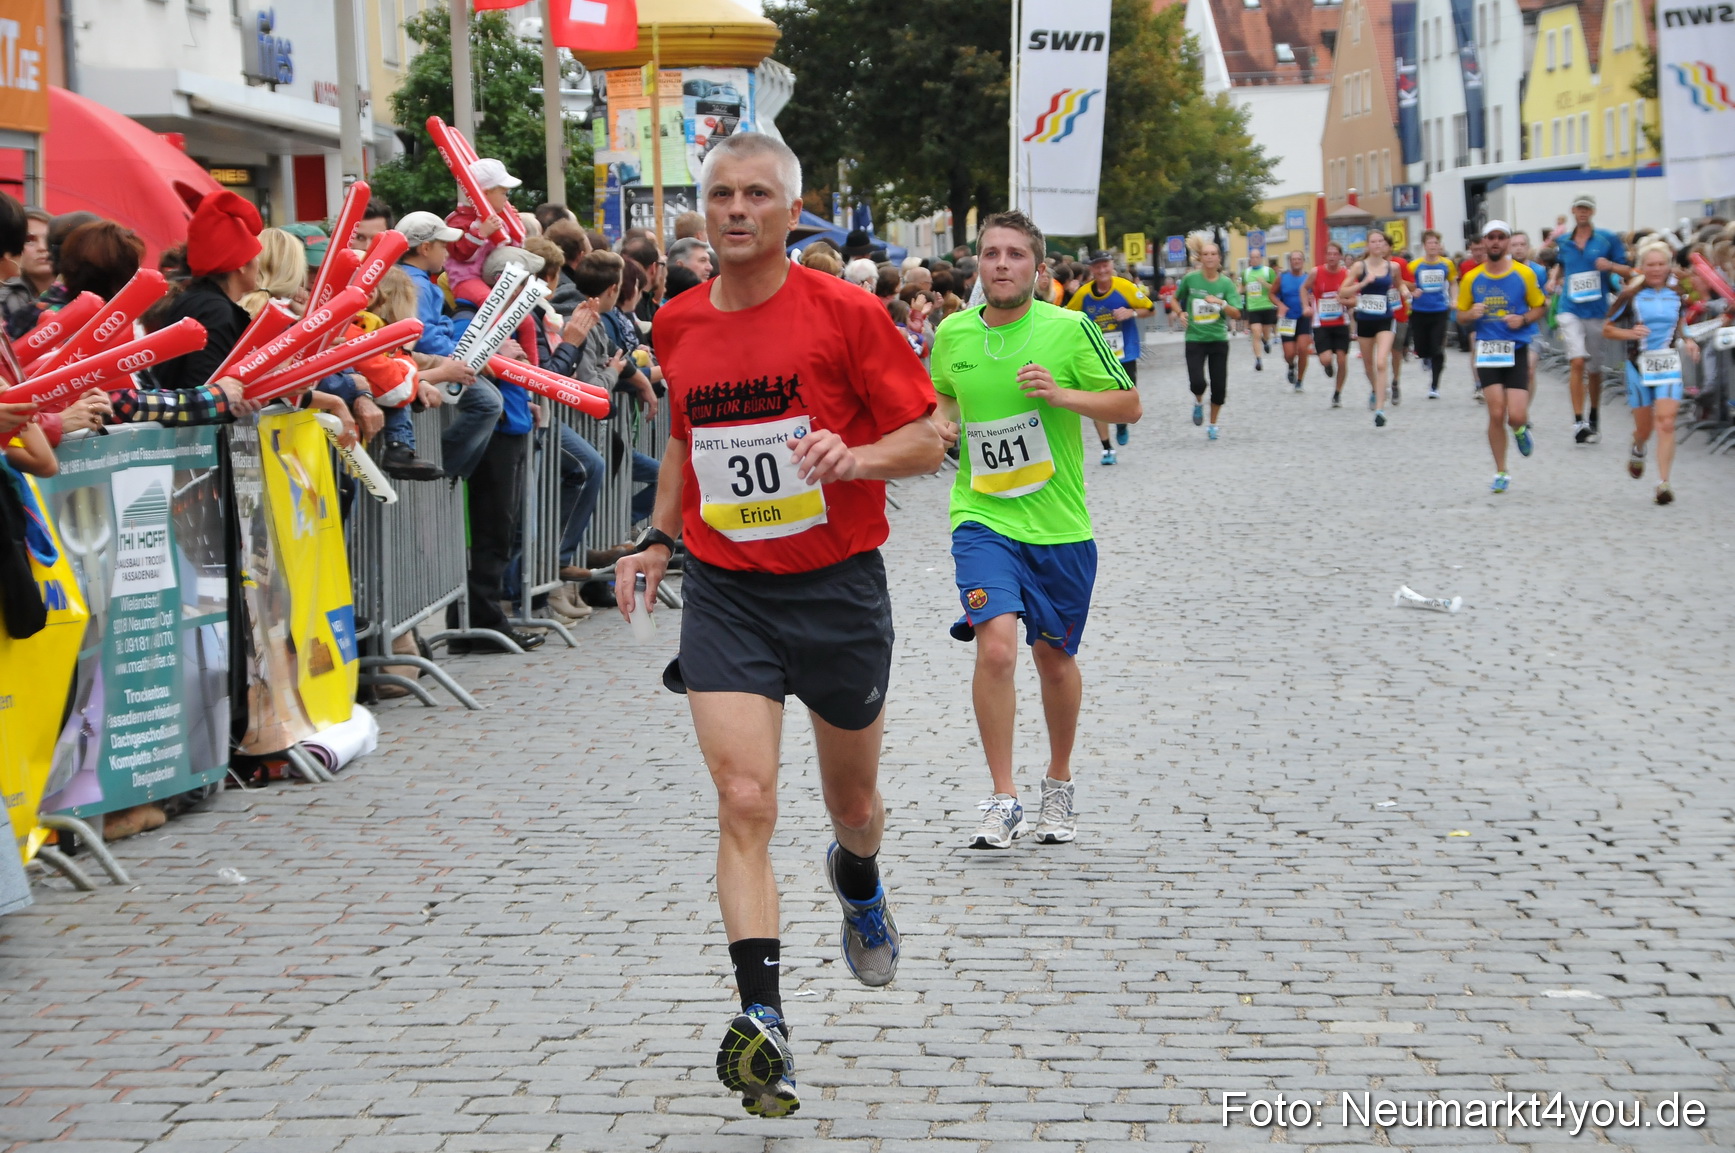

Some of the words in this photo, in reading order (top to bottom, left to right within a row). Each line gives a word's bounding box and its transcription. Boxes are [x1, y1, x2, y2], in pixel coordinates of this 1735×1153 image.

[1028, 29, 1105, 51] swn
[476, 270, 518, 332] Laufsport
[469, 287, 542, 371] mw-laufsport.de
[239, 352, 269, 377] Audi
[267, 333, 297, 356] BKK
[31, 383, 69, 406] Audi
[69, 368, 107, 390] BKK
[501, 368, 527, 385] Audi
[527, 377, 551, 394] BKK
[691, 407, 712, 420] RUN
[715, 398, 741, 418] FOR
[694, 438, 729, 451] PARTL
[731, 431, 789, 450] Neumarkt
[967, 429, 985, 439] PARTL
[986, 422, 1027, 438] Neumarkt
[981, 434, 1030, 470] 641
[728, 452, 781, 498] 30
[740, 505, 782, 524] Erich
[109, 751, 152, 771] Komplette
